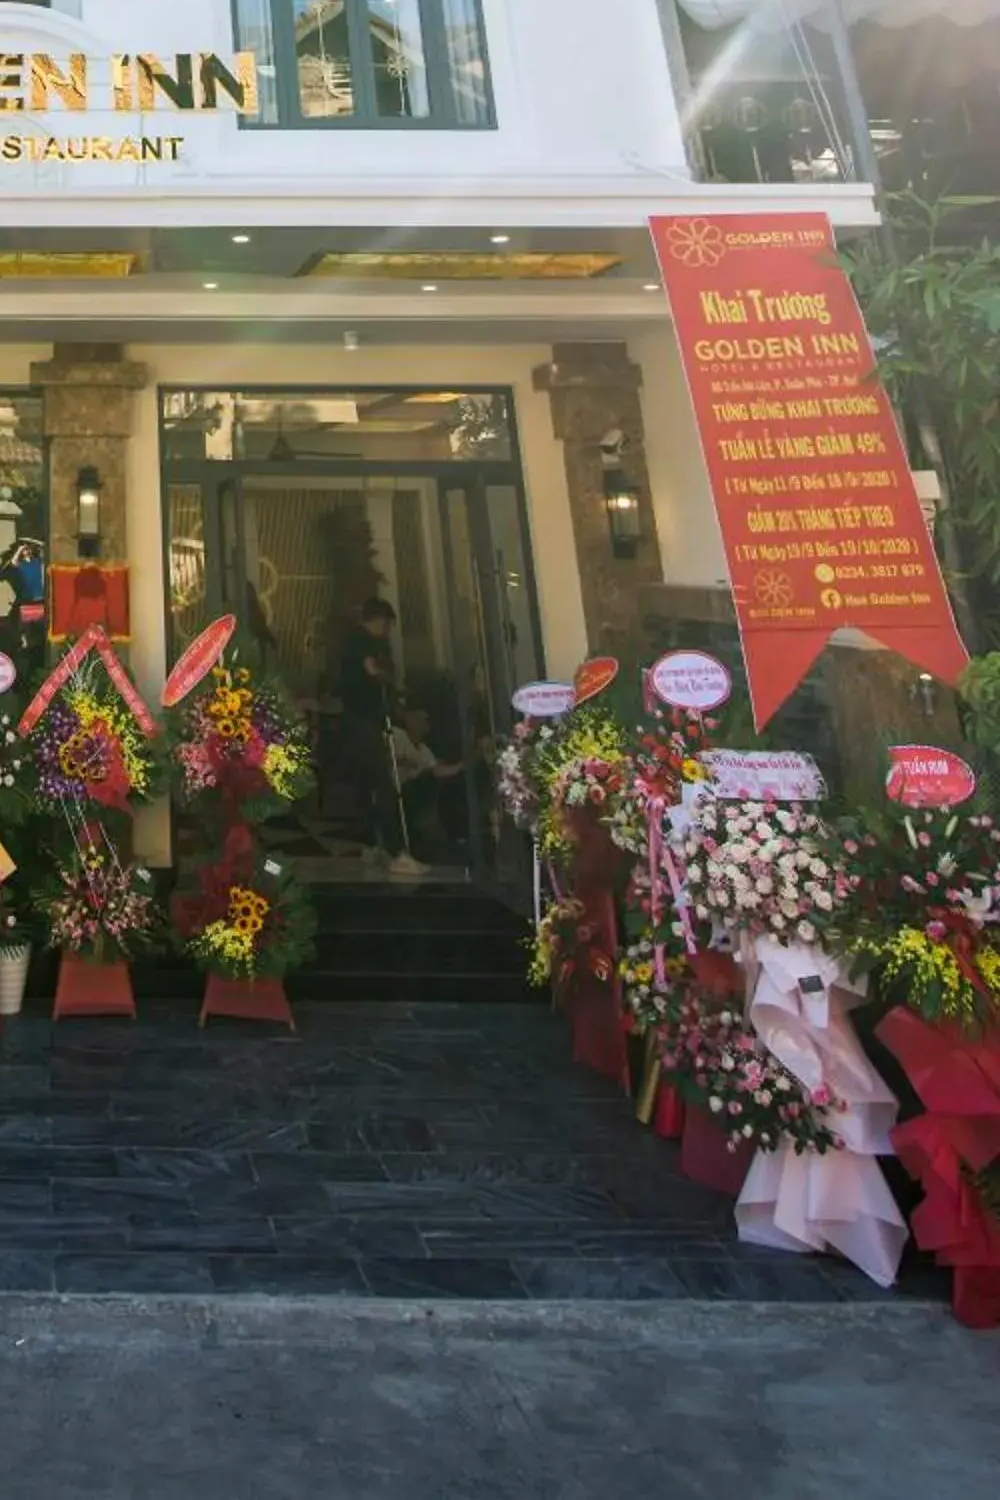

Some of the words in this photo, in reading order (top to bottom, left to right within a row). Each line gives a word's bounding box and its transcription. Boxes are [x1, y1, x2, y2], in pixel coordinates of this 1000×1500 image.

[113, 49, 260, 114] INN
[725, 231, 794, 245] GOLDEN
[700, 289, 749, 324] Khai
[747, 289, 832, 325] Trương
[694, 335, 805, 361] GOLDEN
[810, 331, 860, 355] INN
[855, 431, 886, 454] 49%
